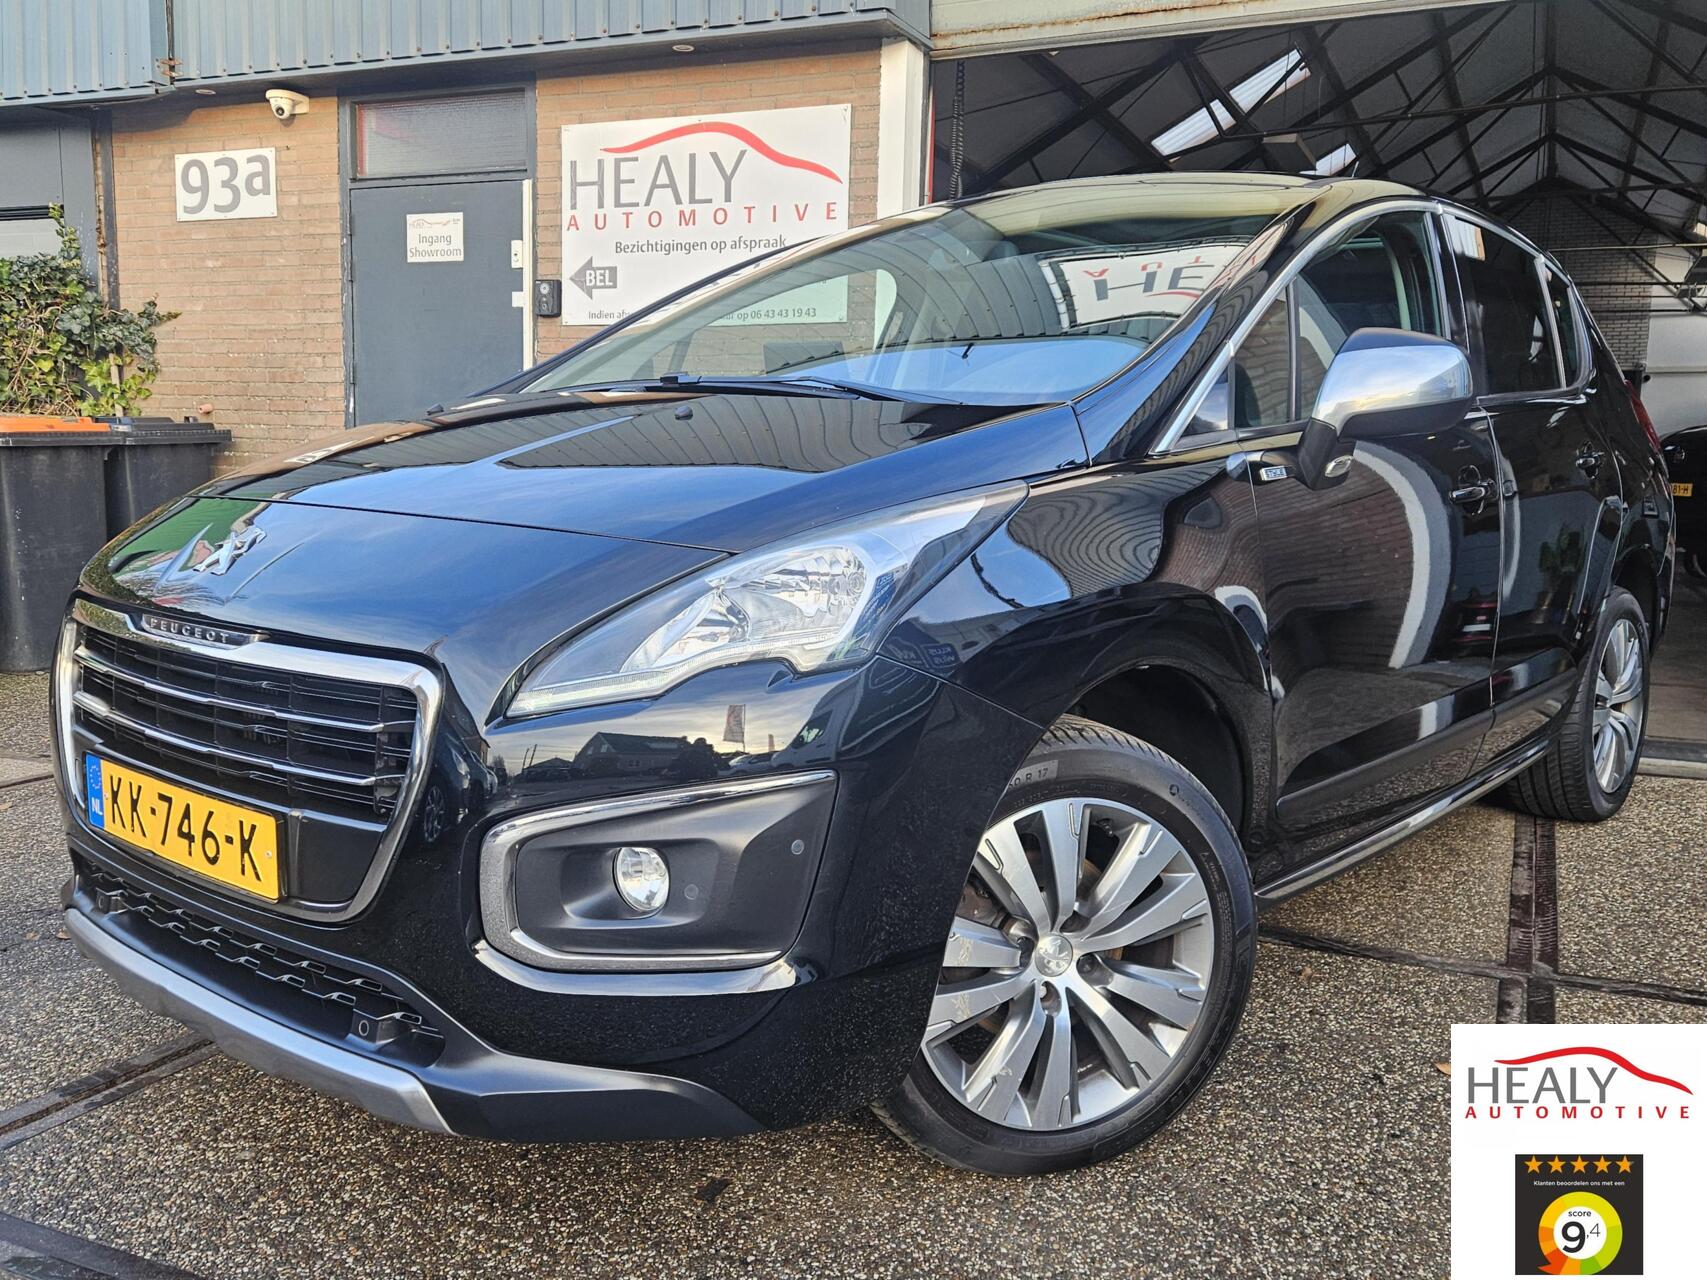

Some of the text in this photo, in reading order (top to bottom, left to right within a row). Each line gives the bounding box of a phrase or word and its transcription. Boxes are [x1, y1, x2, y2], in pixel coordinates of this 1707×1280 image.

[180, 153, 272, 215] 93a
[569, 149, 748, 211] HEALY
[566, 201, 838, 231] AUTOMOTIVE
[418, 233, 452, 247] Ingang
[615, 235, 787, 256] Bezichtigingen op afspraak
[409, 246, 462, 258] Showroom
[585, 269, 614, 287] BEL
[588, 310, 615, 320] Indien
[736, 312, 749, 321] op
[750, 309, 762, 319] 06
[763, 309, 776, 319] 43
[777, 308, 789, 318] 43
[792, 308, 803, 318] 19
[804, 307, 817, 317] 43
[150, 616, 230, 644] PEUGEOT
[1025, 772, 1033, 782] R
[1037, 767, 1049, 778] 17
[91, 801, 103, 817] NL
[109, 774, 263, 882] KK-746-K
